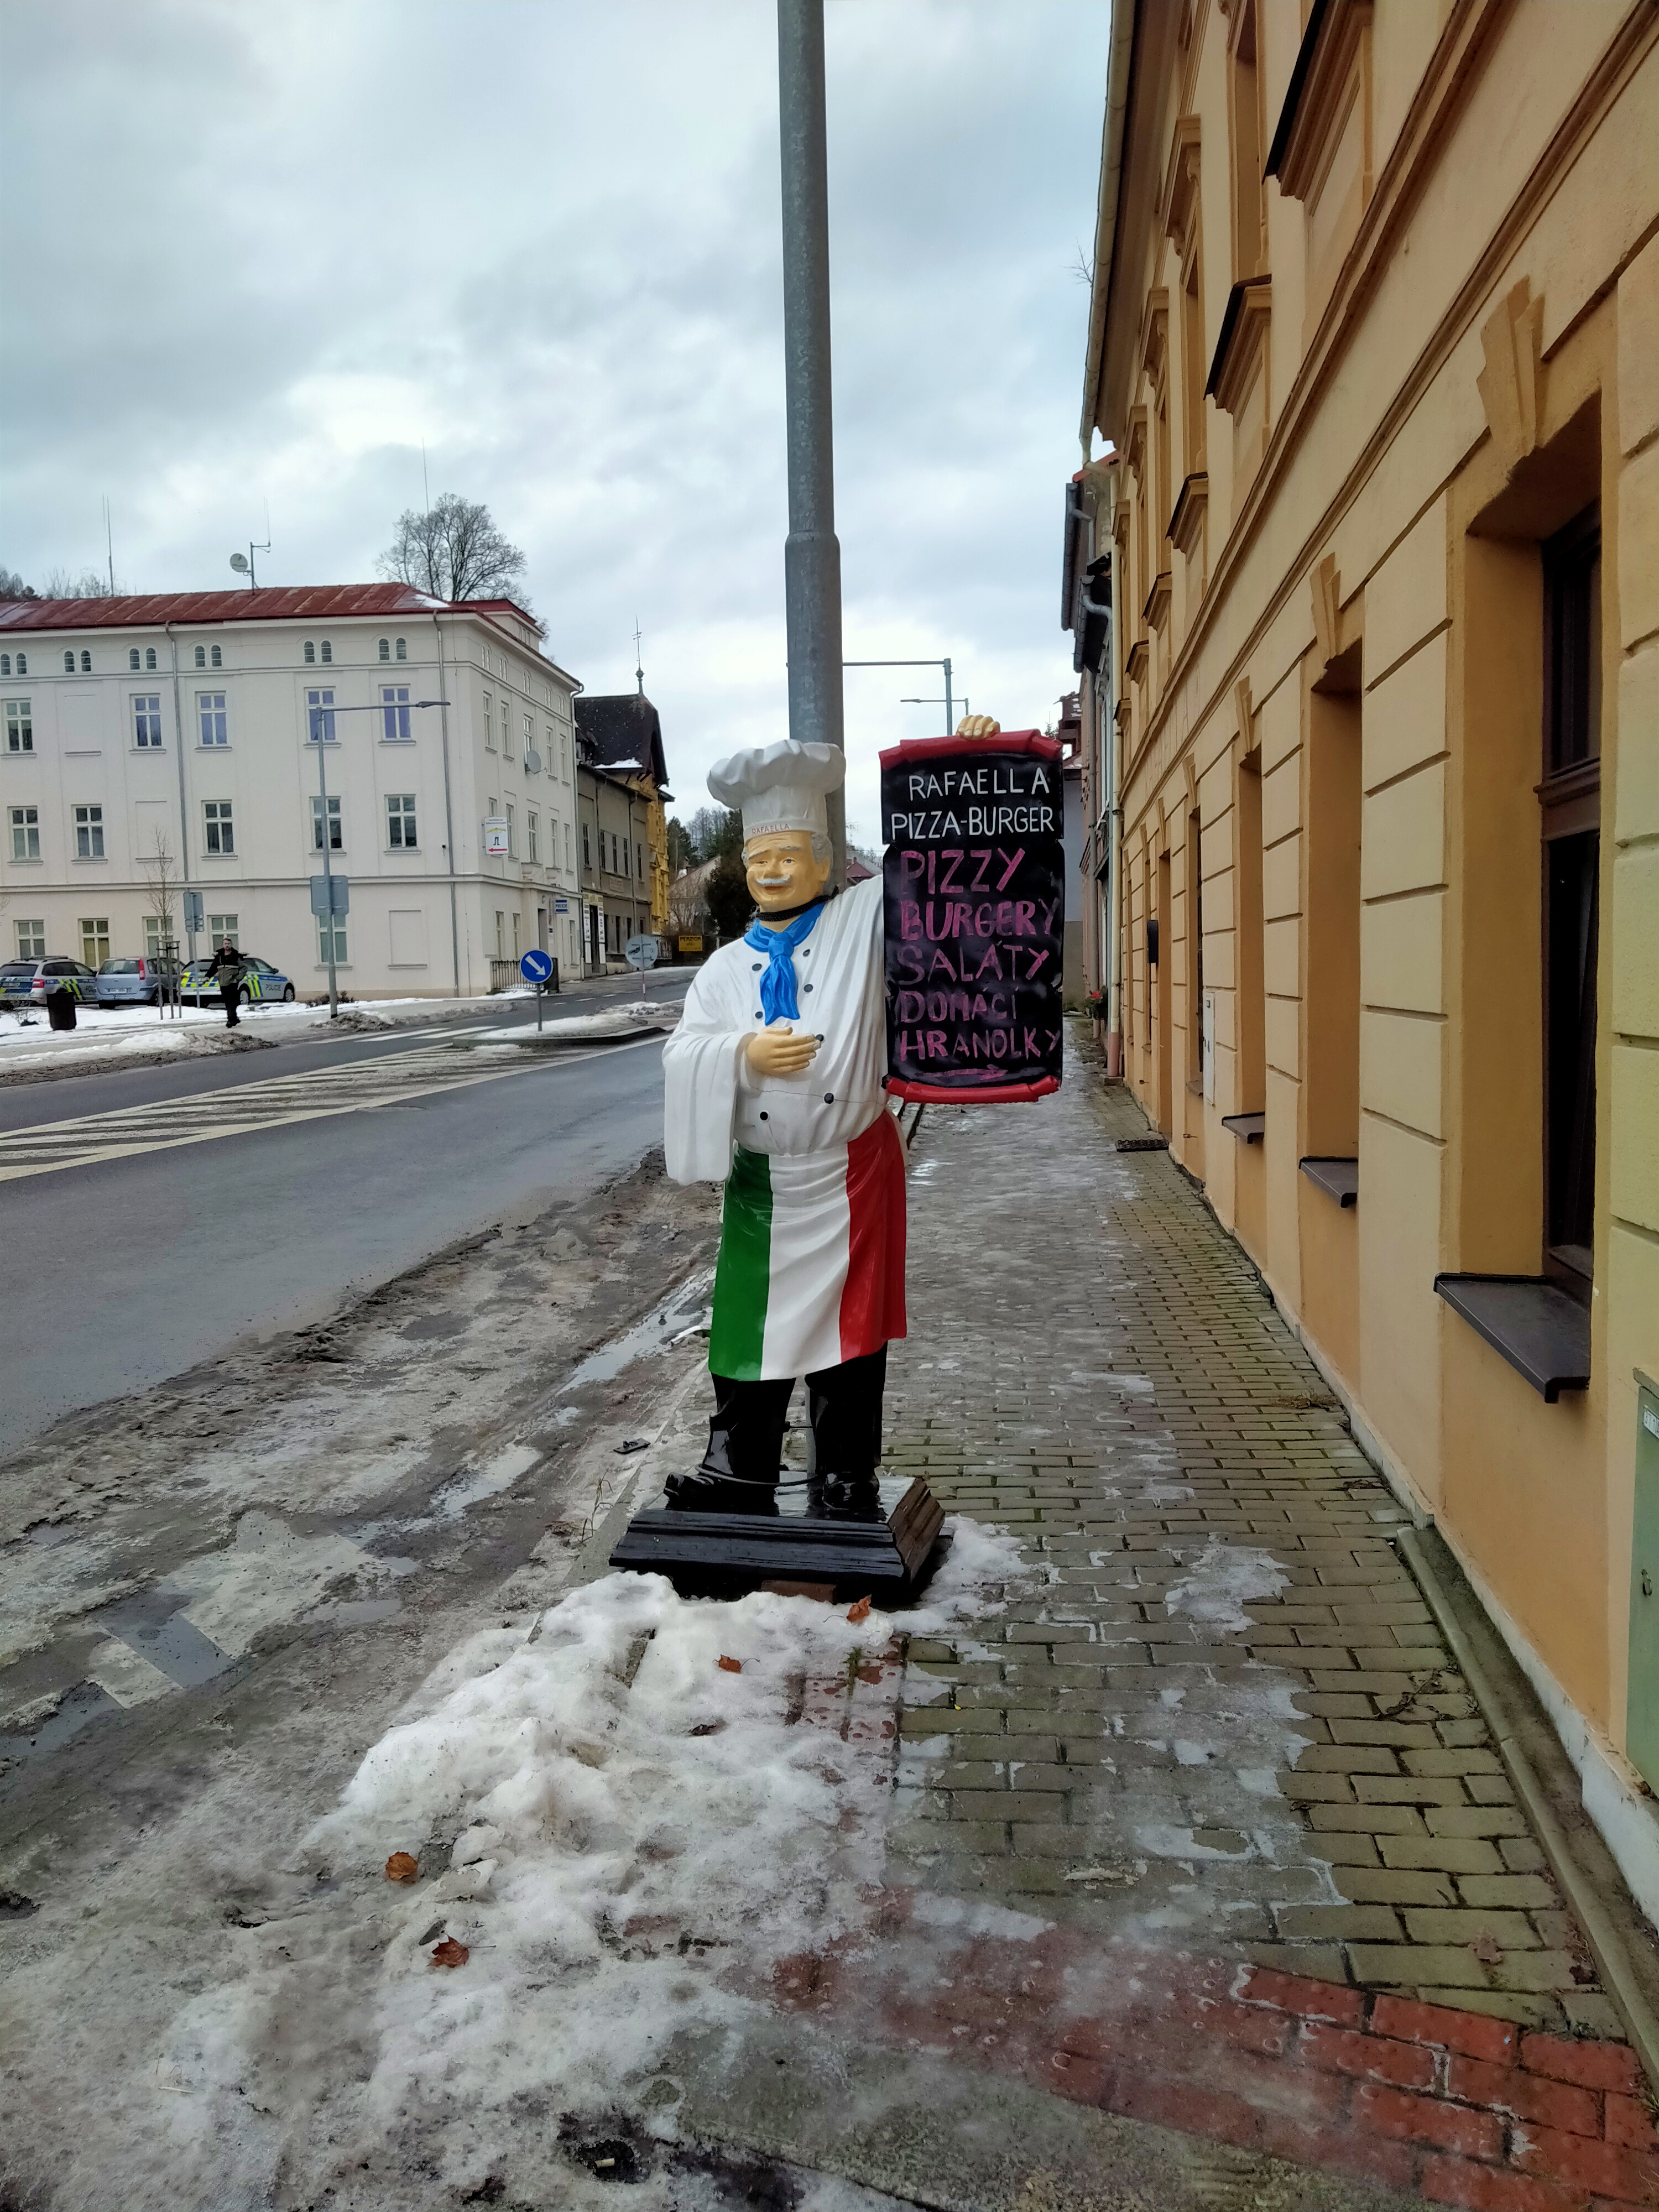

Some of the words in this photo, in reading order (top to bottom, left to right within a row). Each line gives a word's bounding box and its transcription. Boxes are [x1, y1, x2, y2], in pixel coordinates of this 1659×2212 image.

[909, 767, 1050, 801] RAFAELLA
[752, 823, 790, 835] RAFAELLA
[891, 806, 1055, 841] PIZZA-BURGER
[900, 847, 1025, 895] PIZZY
[900, 897, 1059, 941] BURGERY
[897, 940, 1050, 985] SALÁTY
[899, 987, 1019, 1023] DOMÁCÍ
[899, 1026, 1061, 1062] HRANOLKY
